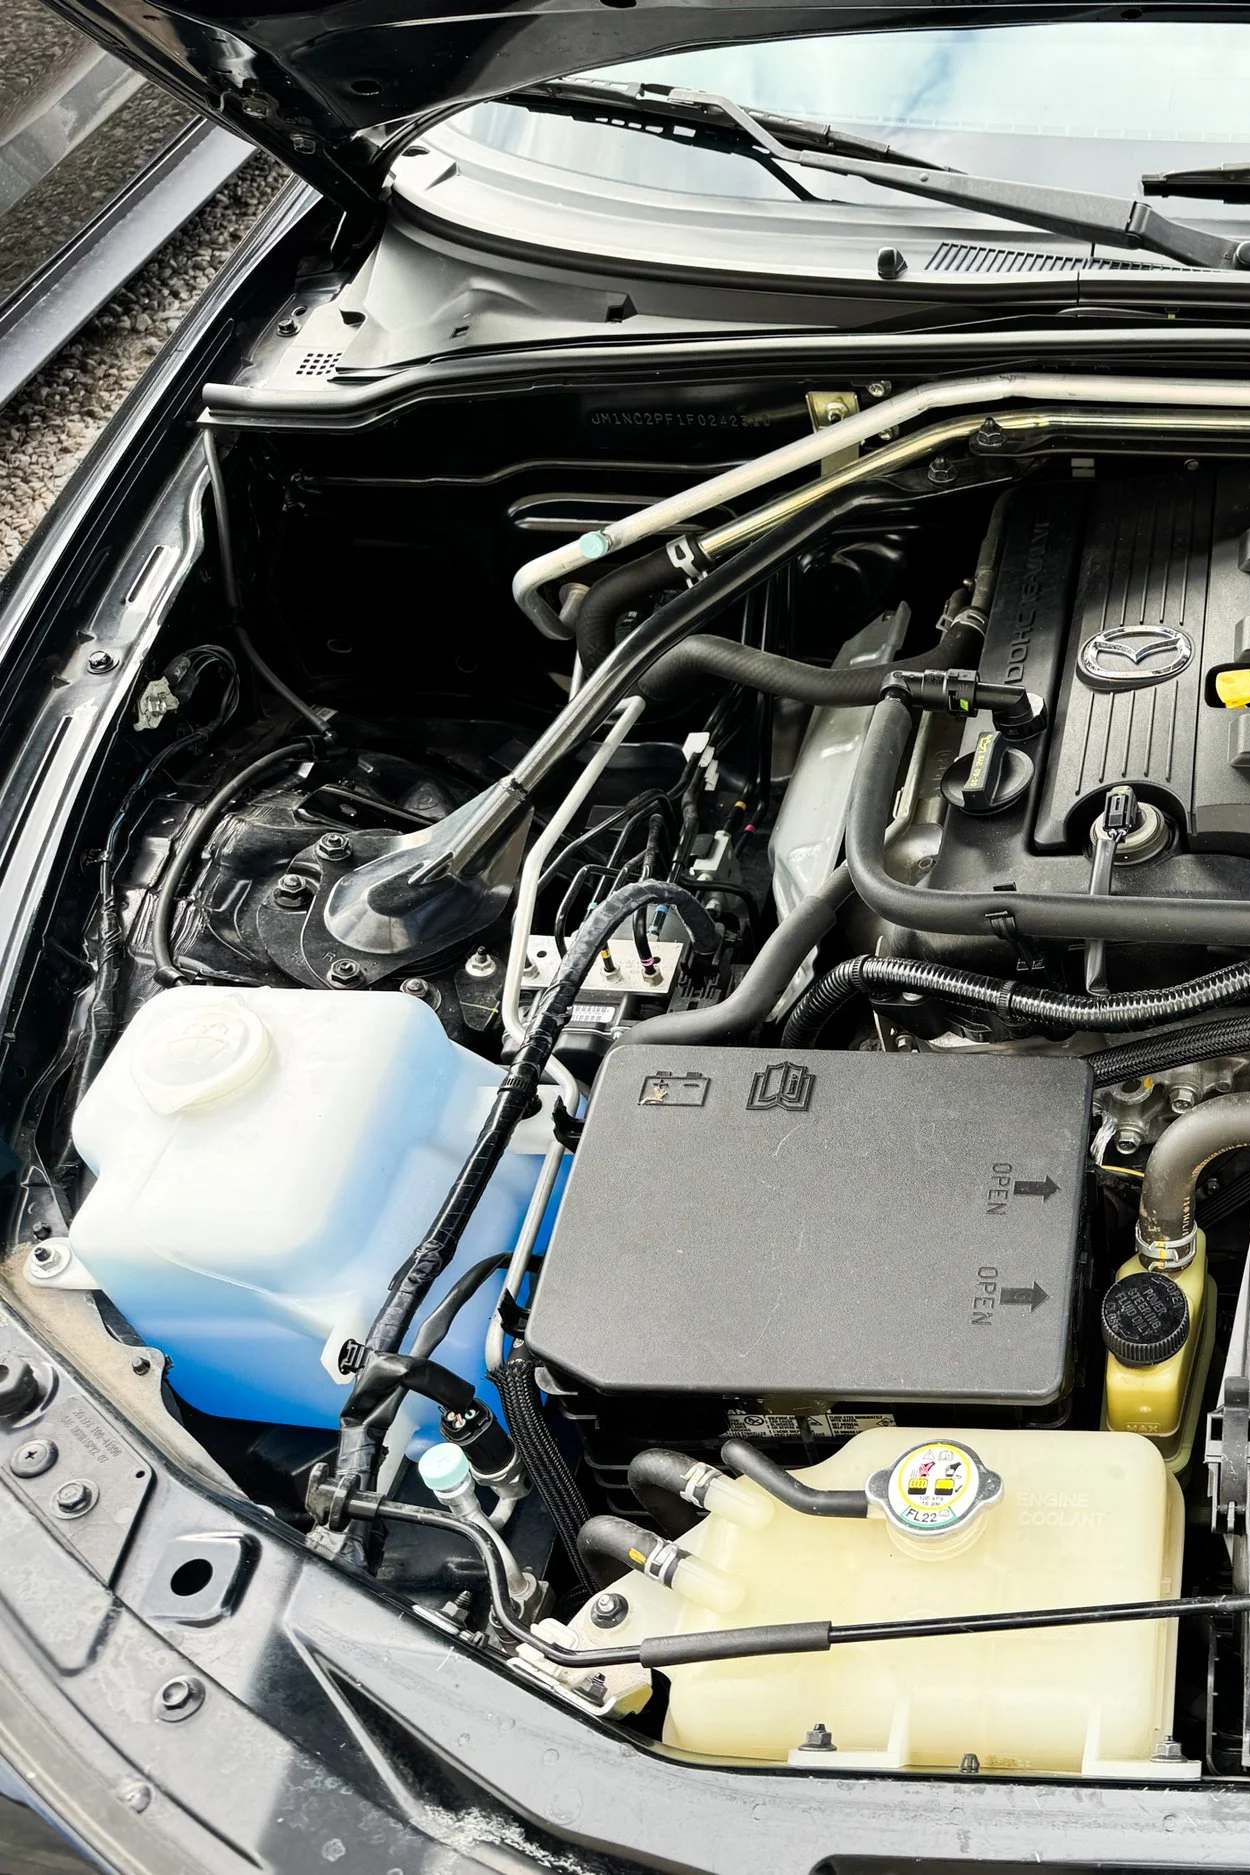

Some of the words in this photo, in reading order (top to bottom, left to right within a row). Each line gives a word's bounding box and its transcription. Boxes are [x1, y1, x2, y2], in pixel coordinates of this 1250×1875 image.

[986, 1162, 1013, 1216] OPEN
[971, 1266, 999, 1326] OPEN
[1143, 1287, 1167, 1316] POWER
[1115, 1292, 1138, 1317] FLUID
[1132, 1315, 1151, 1336] ONLY
[1126, 1424, 1159, 1432] MAX
[1018, 1492, 1091, 1508] ENGINE
[906, 1508, 937, 1523] FL22
[1020, 1511, 1107, 1528] COOLANT
